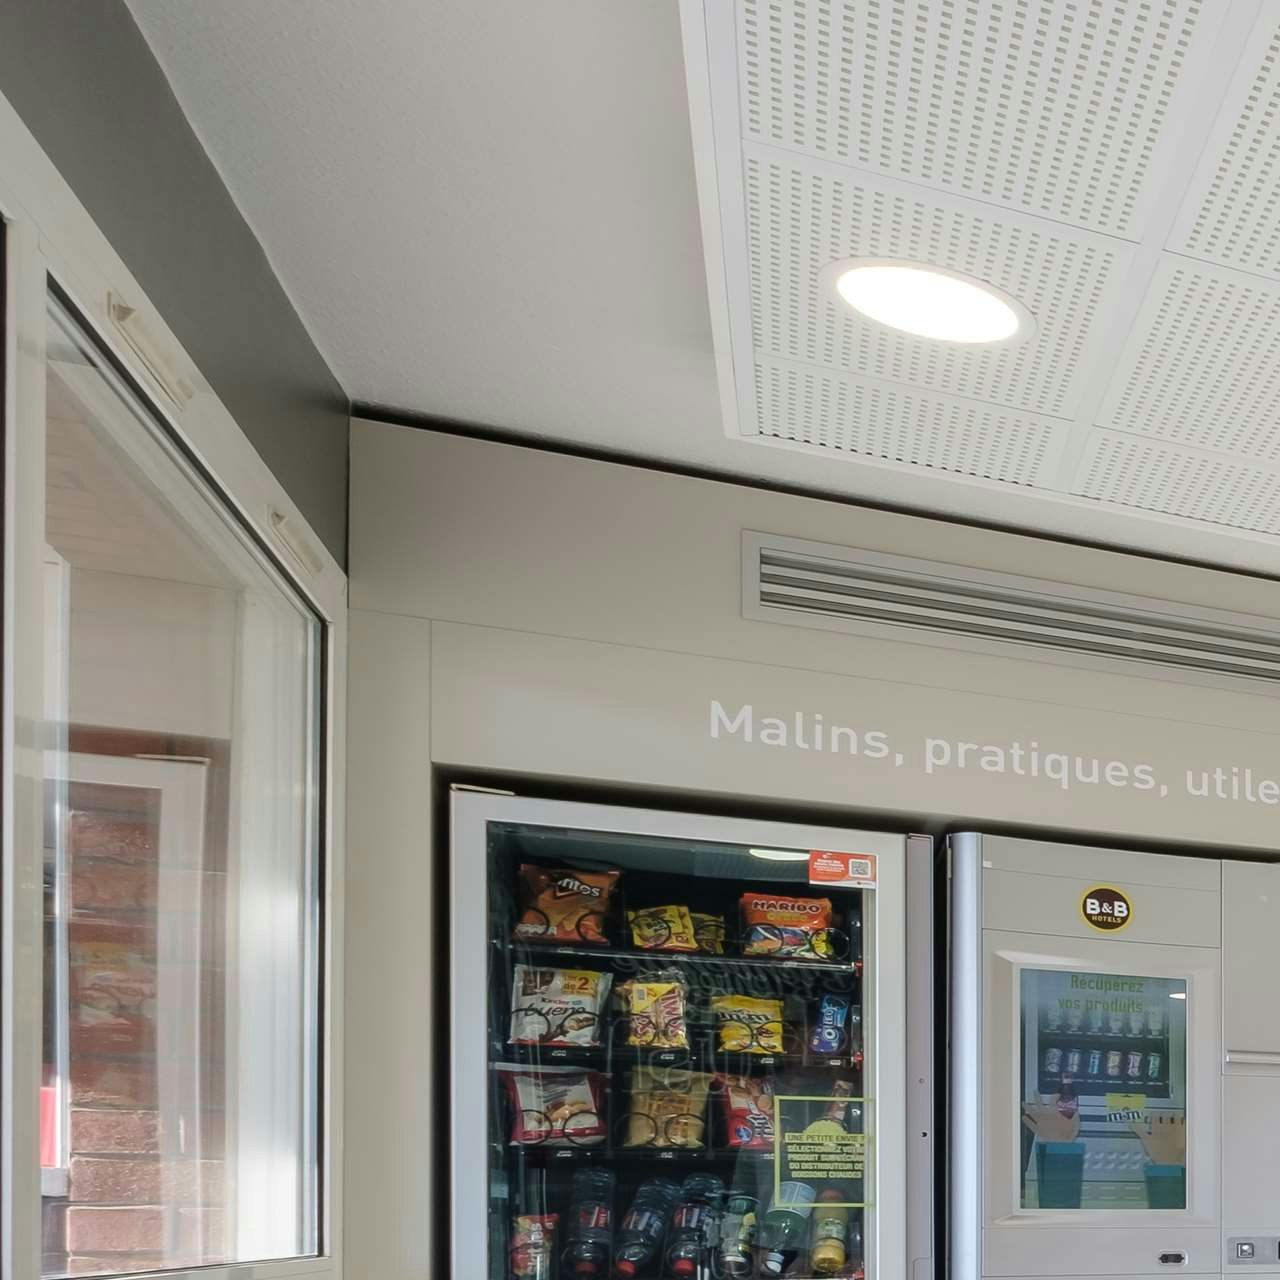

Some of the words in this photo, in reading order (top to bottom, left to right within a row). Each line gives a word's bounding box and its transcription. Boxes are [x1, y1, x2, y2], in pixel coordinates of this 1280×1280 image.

[709, 700, 904, 767] Malins,
[924, 735, 1169, 797] pratiques,
[752, 900, 821, 913] HARIBO
[1085, 898, 1128, 917] B&B
[1091, 915, 1122, 923] HOTELS
[577, 976, 590, 991] 2
[525, 1003, 586, 1017] bueno
[1057, 998, 1081, 1009] vos
[806, 1134, 832, 1142] PETITE
